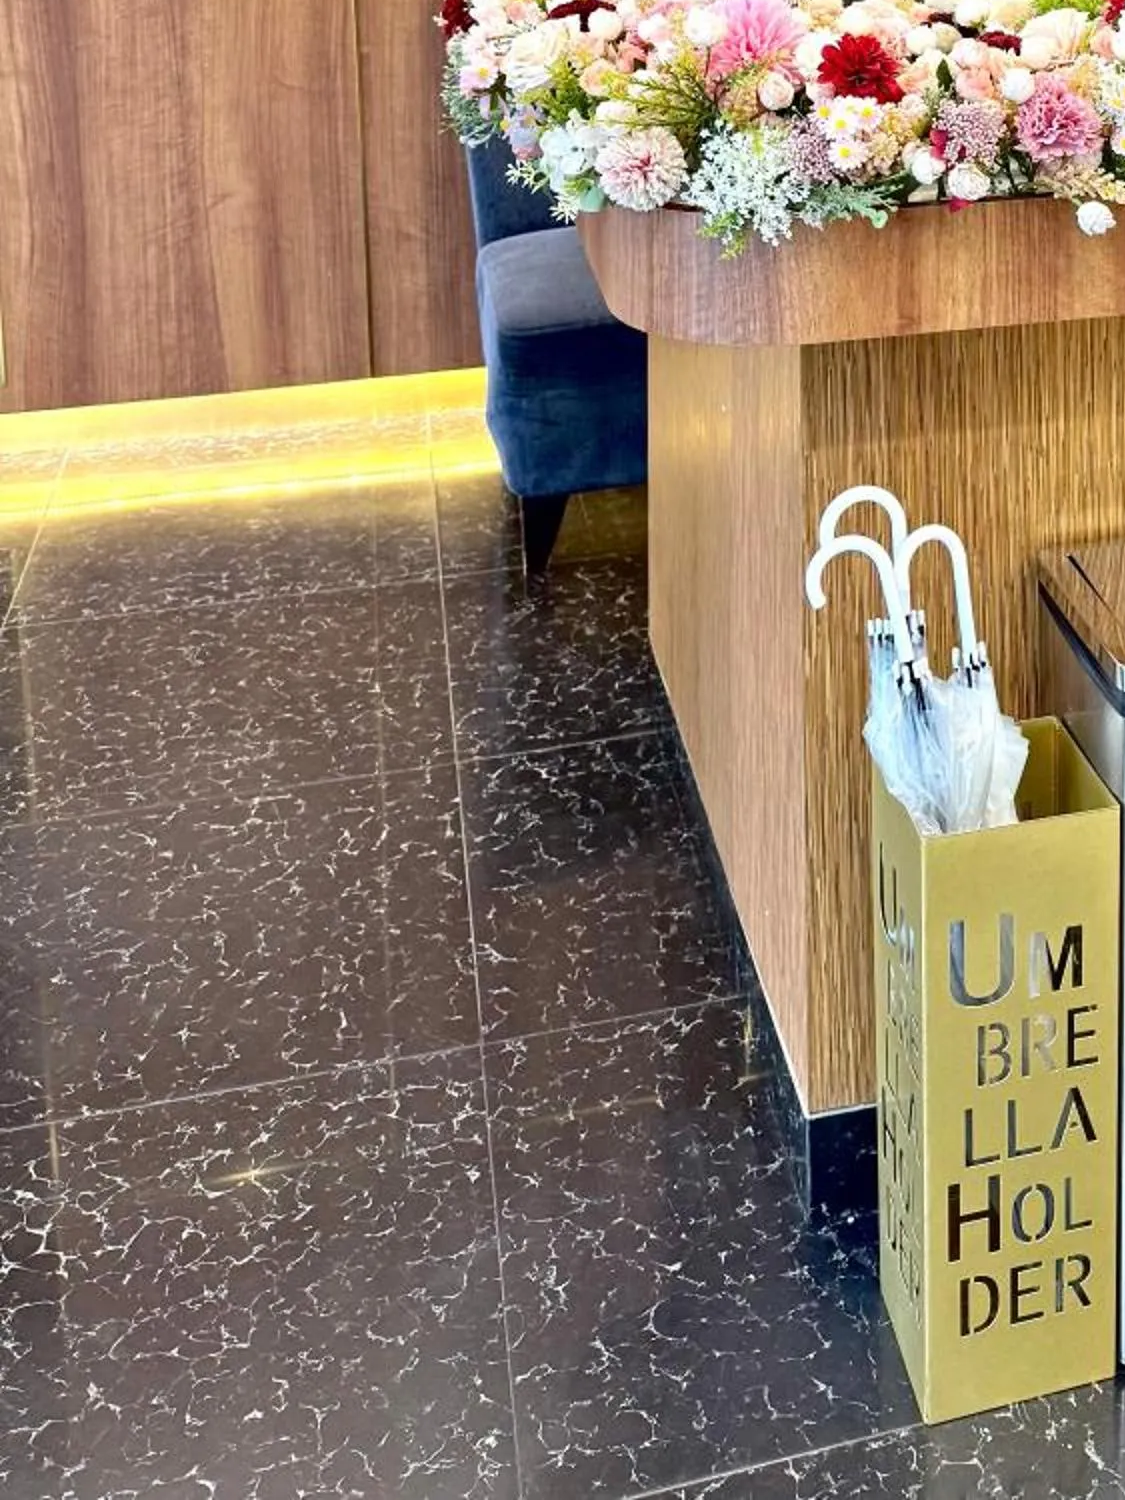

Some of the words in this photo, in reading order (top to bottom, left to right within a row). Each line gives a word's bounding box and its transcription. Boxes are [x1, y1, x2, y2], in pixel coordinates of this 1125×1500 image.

[948, 913, 1085, 1007] UM
[976, 1003, 1099, 1088] BRE
[963, 1086, 1098, 1168] LLA
[947, 1174, 1093, 1263] HOL
[959, 1254, 1092, 1338] DER
